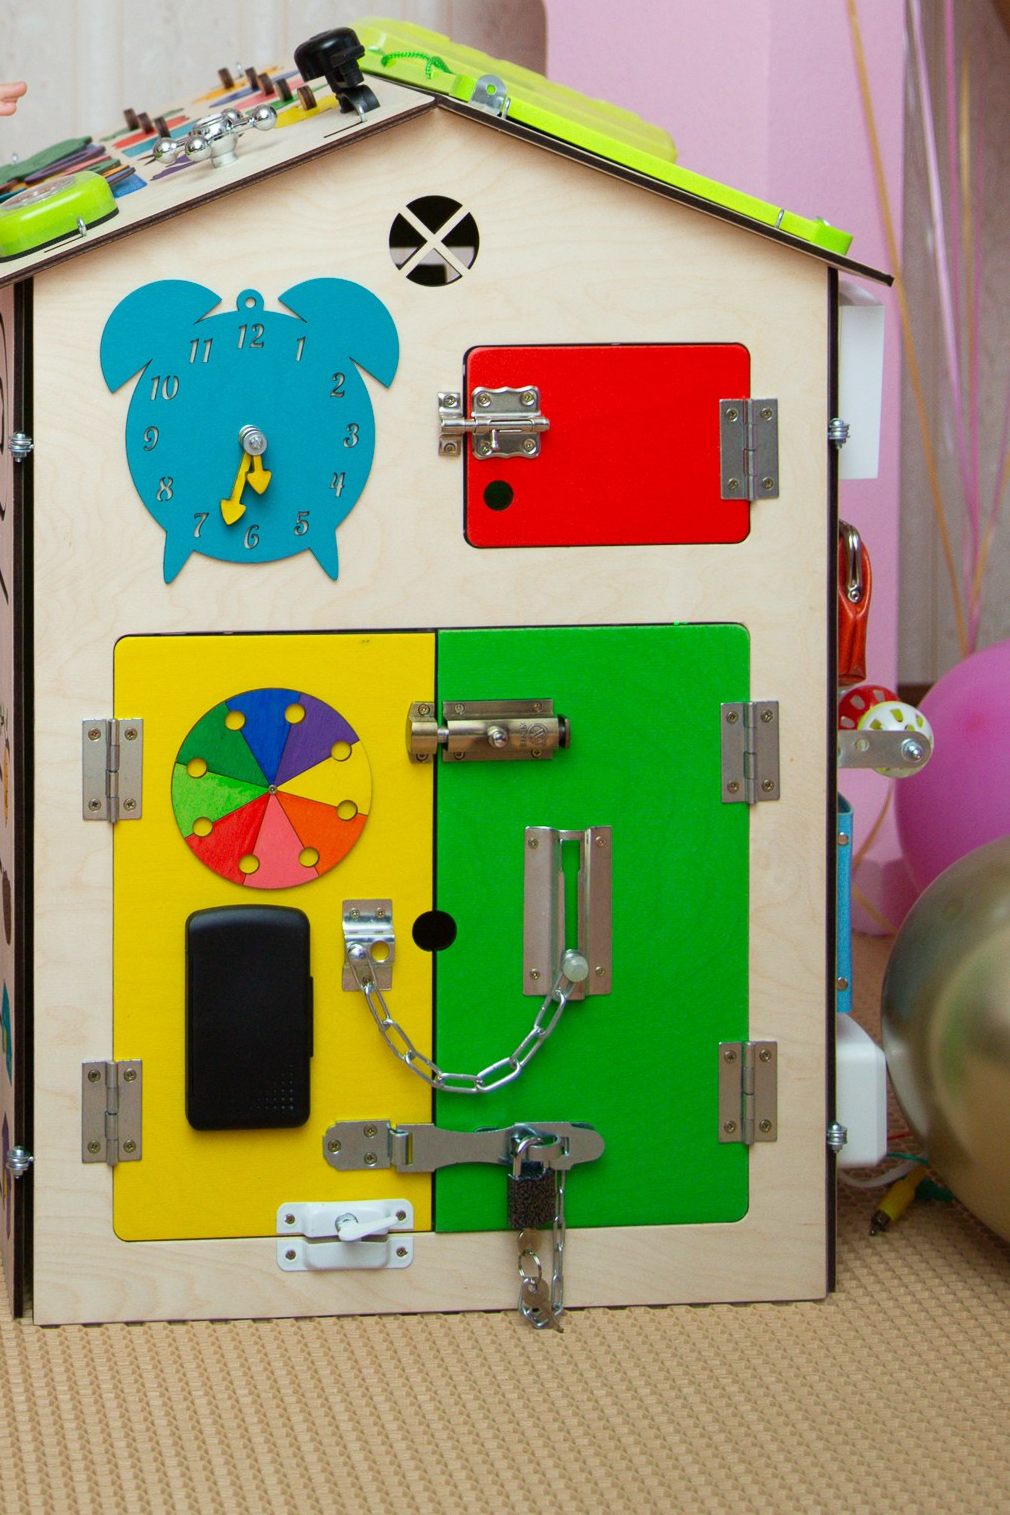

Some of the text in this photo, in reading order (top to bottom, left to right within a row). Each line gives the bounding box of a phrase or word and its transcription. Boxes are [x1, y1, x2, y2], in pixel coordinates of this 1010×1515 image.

[237, 323, 265, 349] 12
[295, 336, 306, 362] 1
[189, 337, 214, 364] 11
[150, 375, 180, 401] 10
[329, 372, 346, 398] 2
[143, 426, 160, 452] 9
[343, 422, 360, 448] 3
[155, 476, 174, 502] 8
[329, 471, 346, 498] 4
[193, 512, 210, 538] 7
[293, 510, 311, 536] 5
[243, 524, 260, 550] 6
